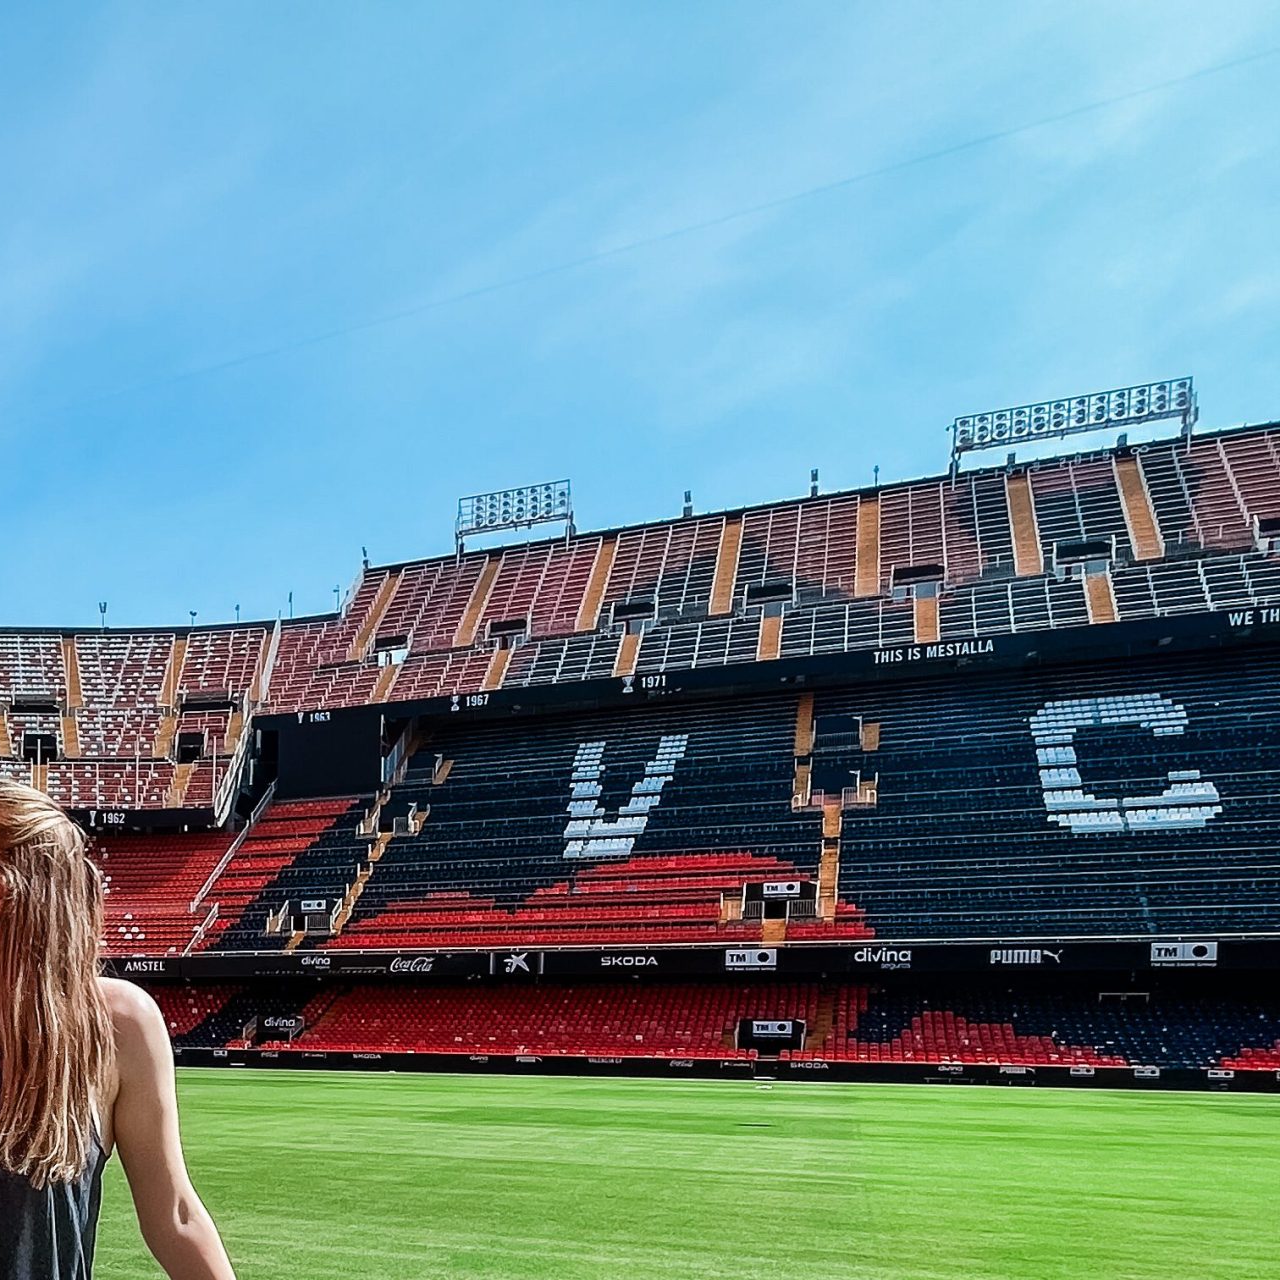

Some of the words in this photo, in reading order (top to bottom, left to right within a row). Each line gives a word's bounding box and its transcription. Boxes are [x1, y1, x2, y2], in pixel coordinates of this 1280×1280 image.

[1228, 610, 1254, 627] WE
[873, 649, 904, 664] THIS
[907, 647, 921, 661] IS
[926, 639, 995, 659] MESTALLA
[641, 674, 667, 689] 1971
[465, 693, 490, 708] 1967
[562, 733, 690, 859] V
[1029, 692, 1224, 835] C
[102, 811, 126, 825] 1962
[729, 953, 747, 963] TM
[854, 947, 912, 963] divina
[990, 949, 1041, 964] PUMA
[1155, 947, 1179, 958] TM
[124, 961, 166, 972] AMSTEL
[301, 956, 331, 966] divina
[264, 1016, 296, 1027] divina
